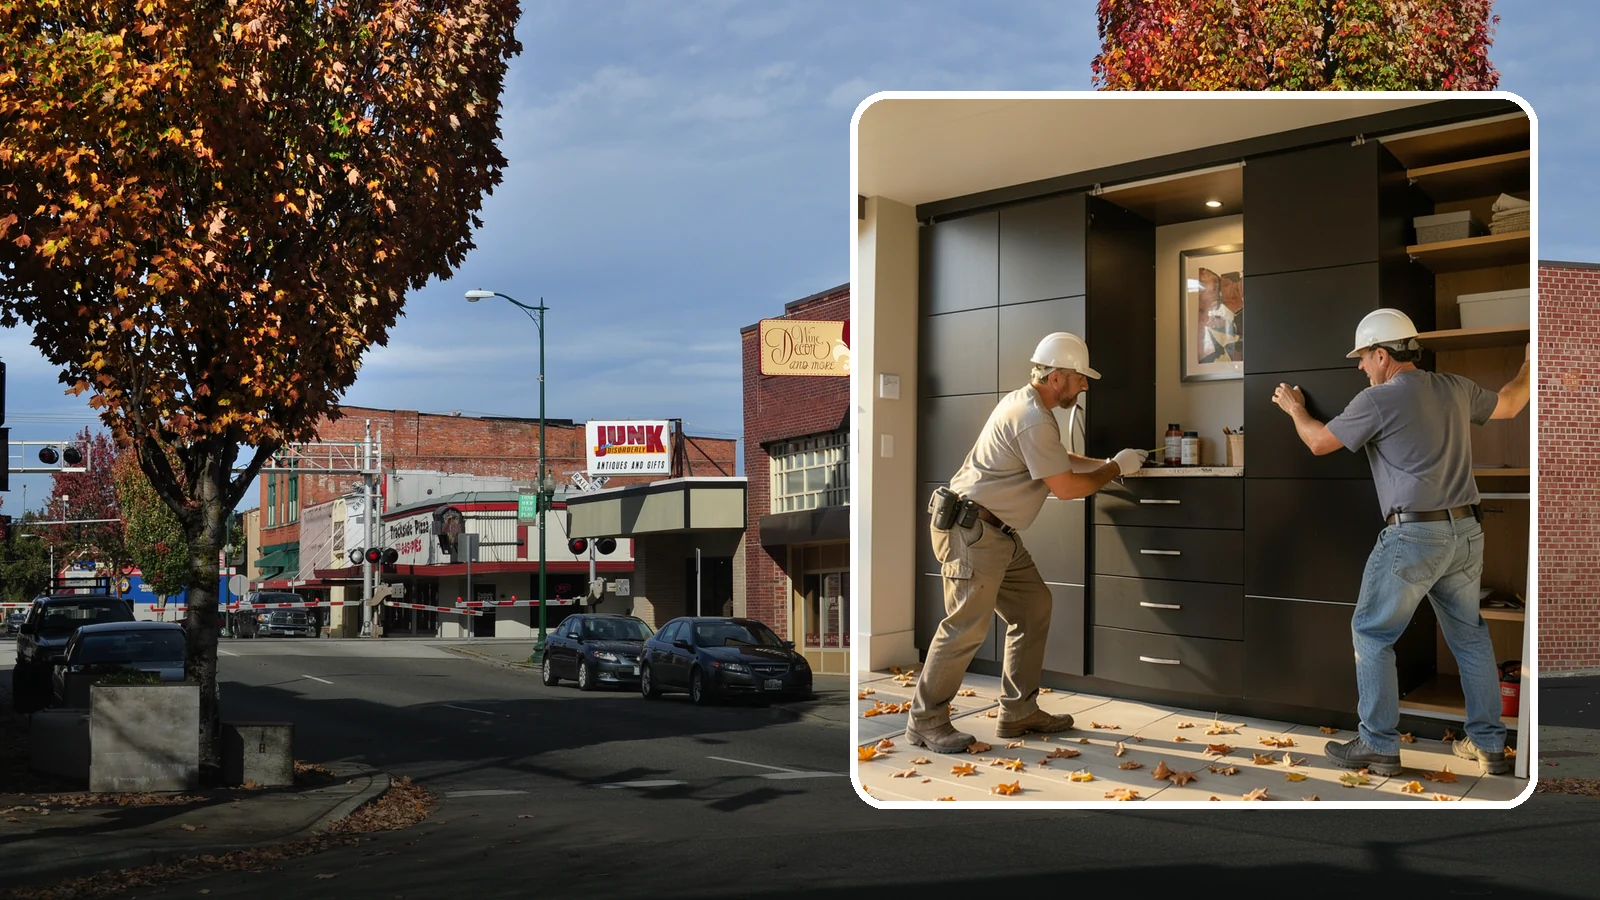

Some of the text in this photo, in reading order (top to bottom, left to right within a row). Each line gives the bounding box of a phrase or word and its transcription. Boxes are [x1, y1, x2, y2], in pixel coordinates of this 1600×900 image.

[765, 328, 831, 365] Decor
[596, 425, 665, 457] JUNK
[607, 446, 646, 454] DISORDERLY
[597, 461, 665, 470] ANTIQUES AND GIFTS
[573, 473, 589, 492] RAIL
[390, 519, 429, 540] Trackside Pizza
